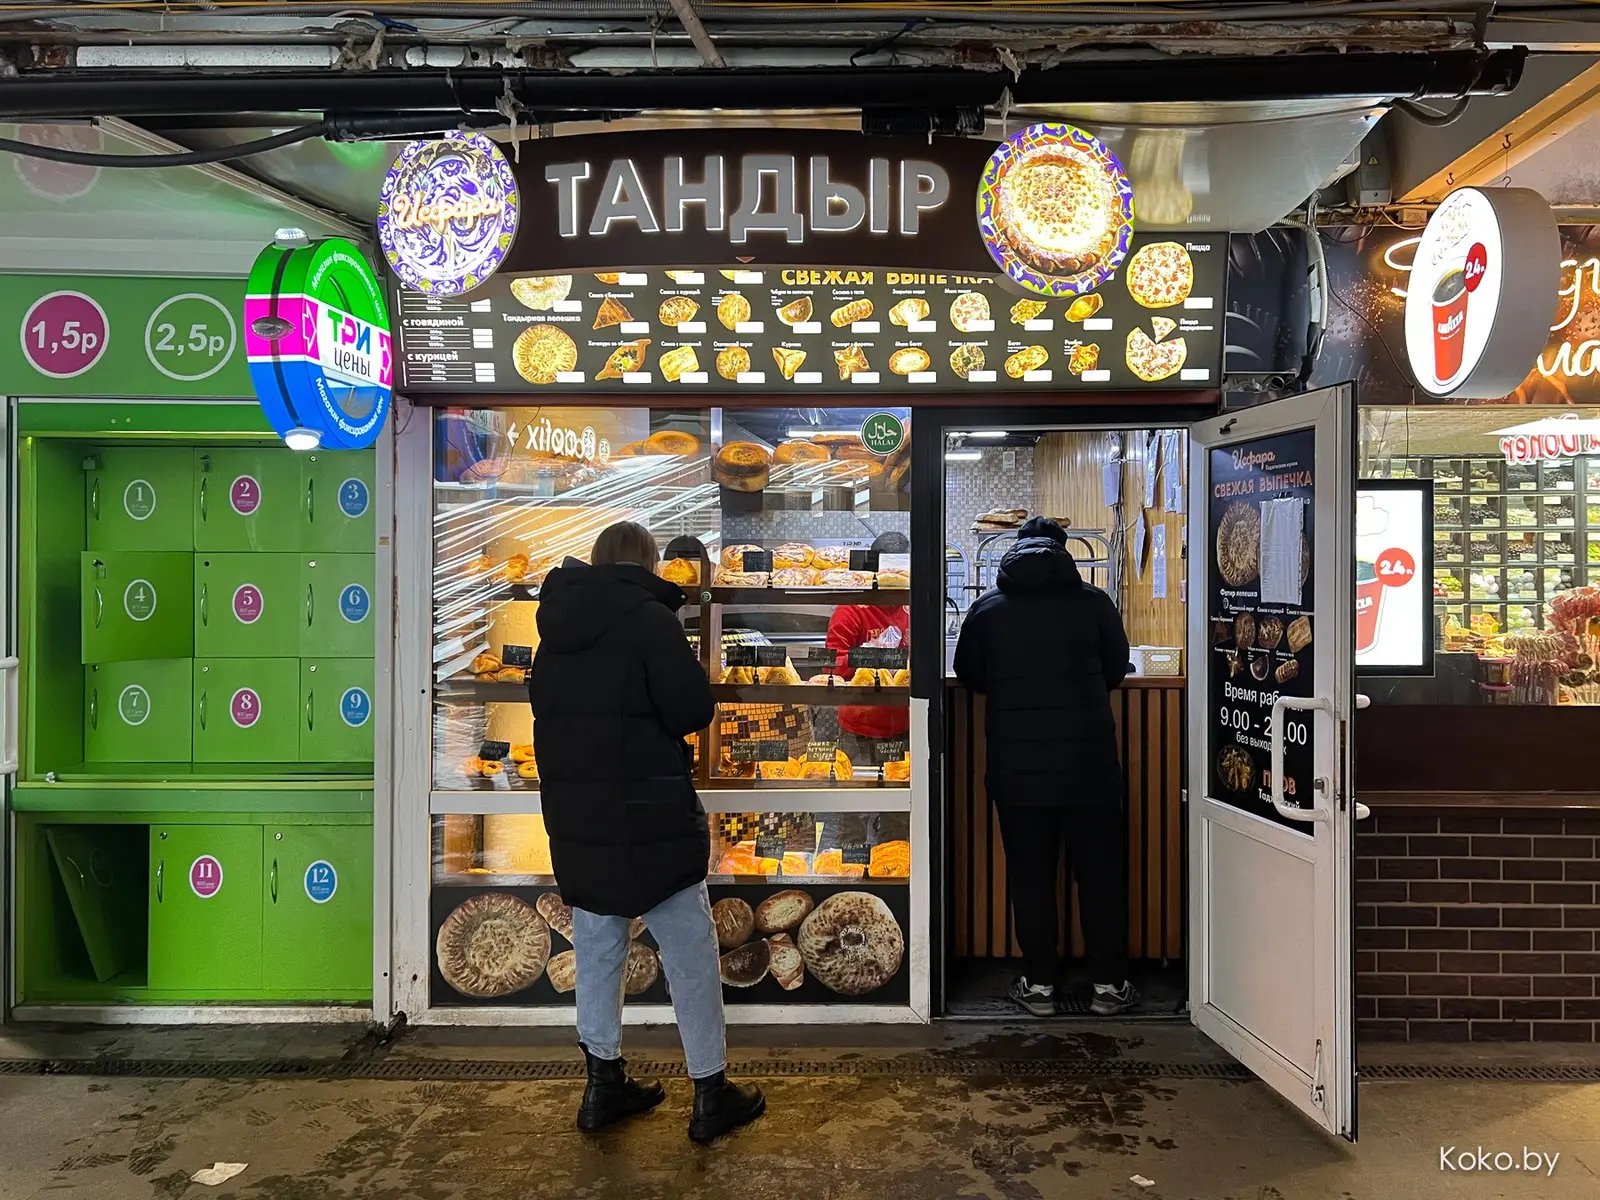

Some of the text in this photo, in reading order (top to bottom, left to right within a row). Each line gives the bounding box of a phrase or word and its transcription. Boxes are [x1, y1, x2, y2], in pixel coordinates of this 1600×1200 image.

[545, 154, 950, 244] ТАНДЫР
[392, 190, 502, 235] Исфара
[781, 270, 874, 285] СВЕЖАЯ
[31, 321, 98, 354] 1,5р
[156, 323, 226, 356] 2,5р
[328, 309, 371, 354] ТРИ
[334, 347, 371, 378] цены
[1232, 448, 1276, 471] Исфара
[136, 487, 144, 501] 1
[239, 482, 251, 497] 2
[348, 484, 358, 499] 3
[1214, 471, 1313, 498] СВЕЖАЯ ВЫПЕЧКА
[134, 587, 146, 602] 4
[243, 590, 253, 605] 5
[349, 590, 360, 605] 6
[129, 691, 140, 707] 7
[240, 694, 252, 710] 8
[350, 693, 361, 709] 9
[1225, 682, 1303, 712] Время раб
[1220, 706, 1250, 731] 9.00
[1264, 716, 1307, 746] 2.00
[1236, 731, 1287, 756] без выход
[1263, 769, 1296, 795] ПОВ
[198, 863, 213, 878] 11
[311, 868, 329, 883] 12
